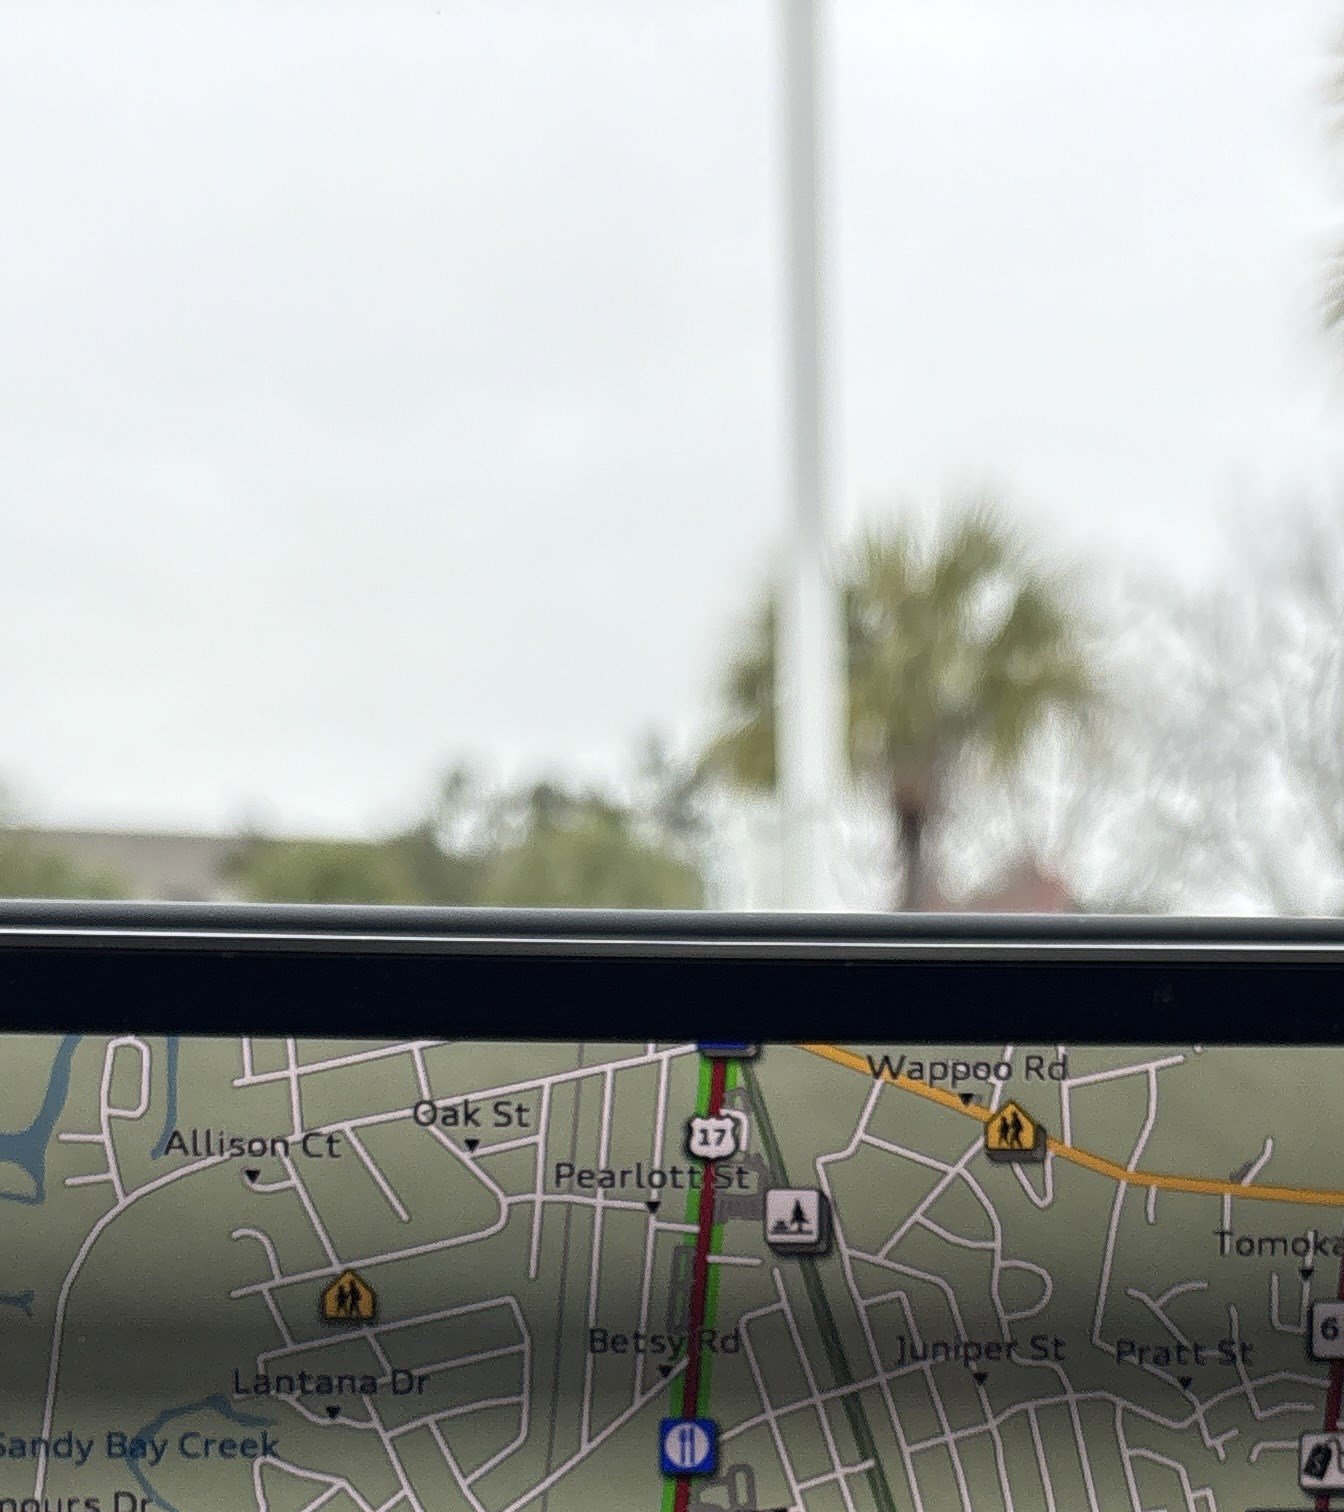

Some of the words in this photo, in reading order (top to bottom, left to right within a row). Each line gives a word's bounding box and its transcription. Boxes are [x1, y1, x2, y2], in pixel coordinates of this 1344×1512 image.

[867, 1054, 1012, 1087] Wappoo
[1025, 1055, 1069, 1082] Rd
[413, 1100, 481, 1128] Oak
[493, 1101, 531, 1128] St
[165, 1129, 290, 1158] Allison
[302, 1132, 343, 1158] Ct
[699, 1127, 727, 1147] 17
[556, 1162, 700, 1190] Pearlott
[714, 1164, 751, 1190] St
[590, 1328, 683, 1360] Betsy
[701, 1327, 742, 1355] Rd
[897, 1334, 1015, 1371] Juniper
[1030, 1336, 1066, 1362] St
[1116, 1340, 1208, 1366] Pratt
[1217, 1338, 1255, 1366] St
[233, 1368, 379, 1397] Lantana
[391, 1368, 427, 1397] Dr
[107, 1431, 169, 1466] Bay
[179, 1430, 280, 1460] Creek
